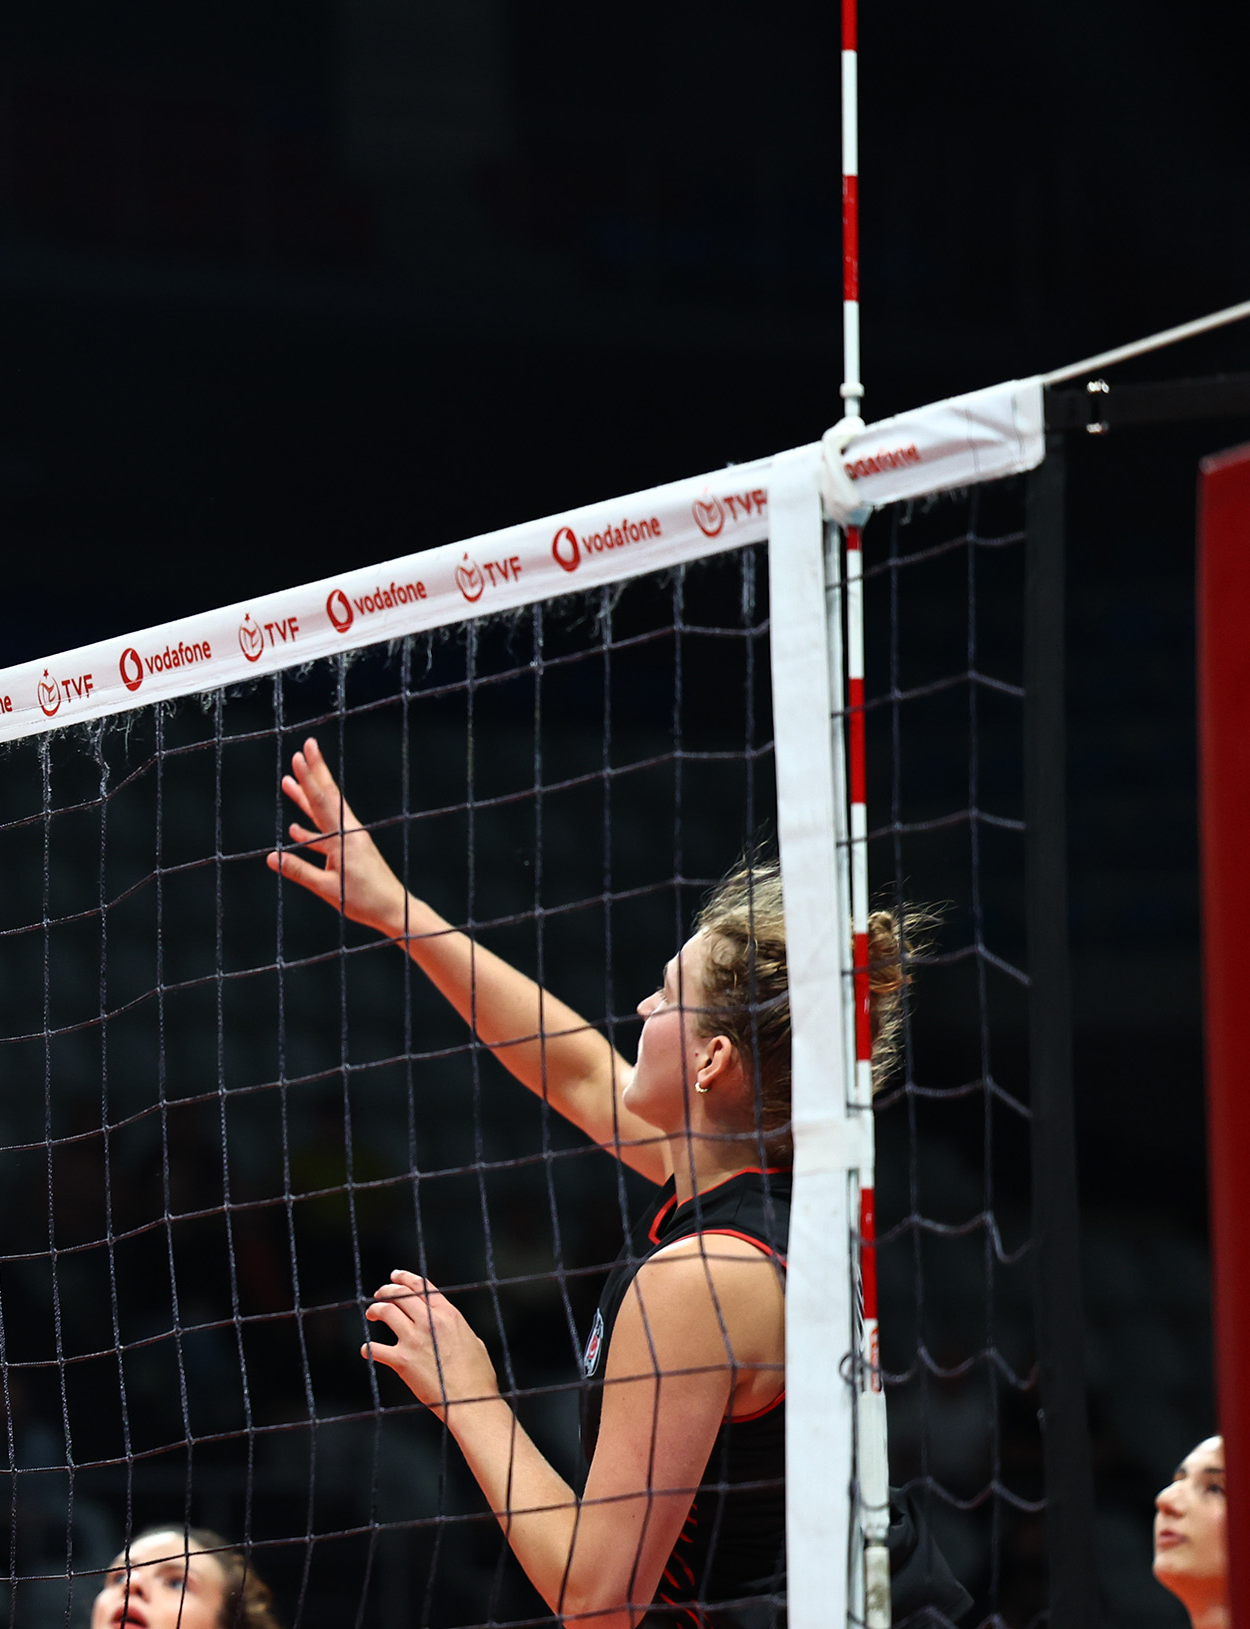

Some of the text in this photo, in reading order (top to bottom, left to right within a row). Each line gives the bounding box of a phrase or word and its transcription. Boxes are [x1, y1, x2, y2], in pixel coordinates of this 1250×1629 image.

[60, 673, 94, 704] TVF
[144, 639, 212, 675] vodafone
[263, 616, 300, 647] TVF
[352, 578, 427, 618] vodafone
[482, 556, 523, 588] TVF
[580, 515, 661, 555] vodafone
[723, 489, 768, 524] TVF
